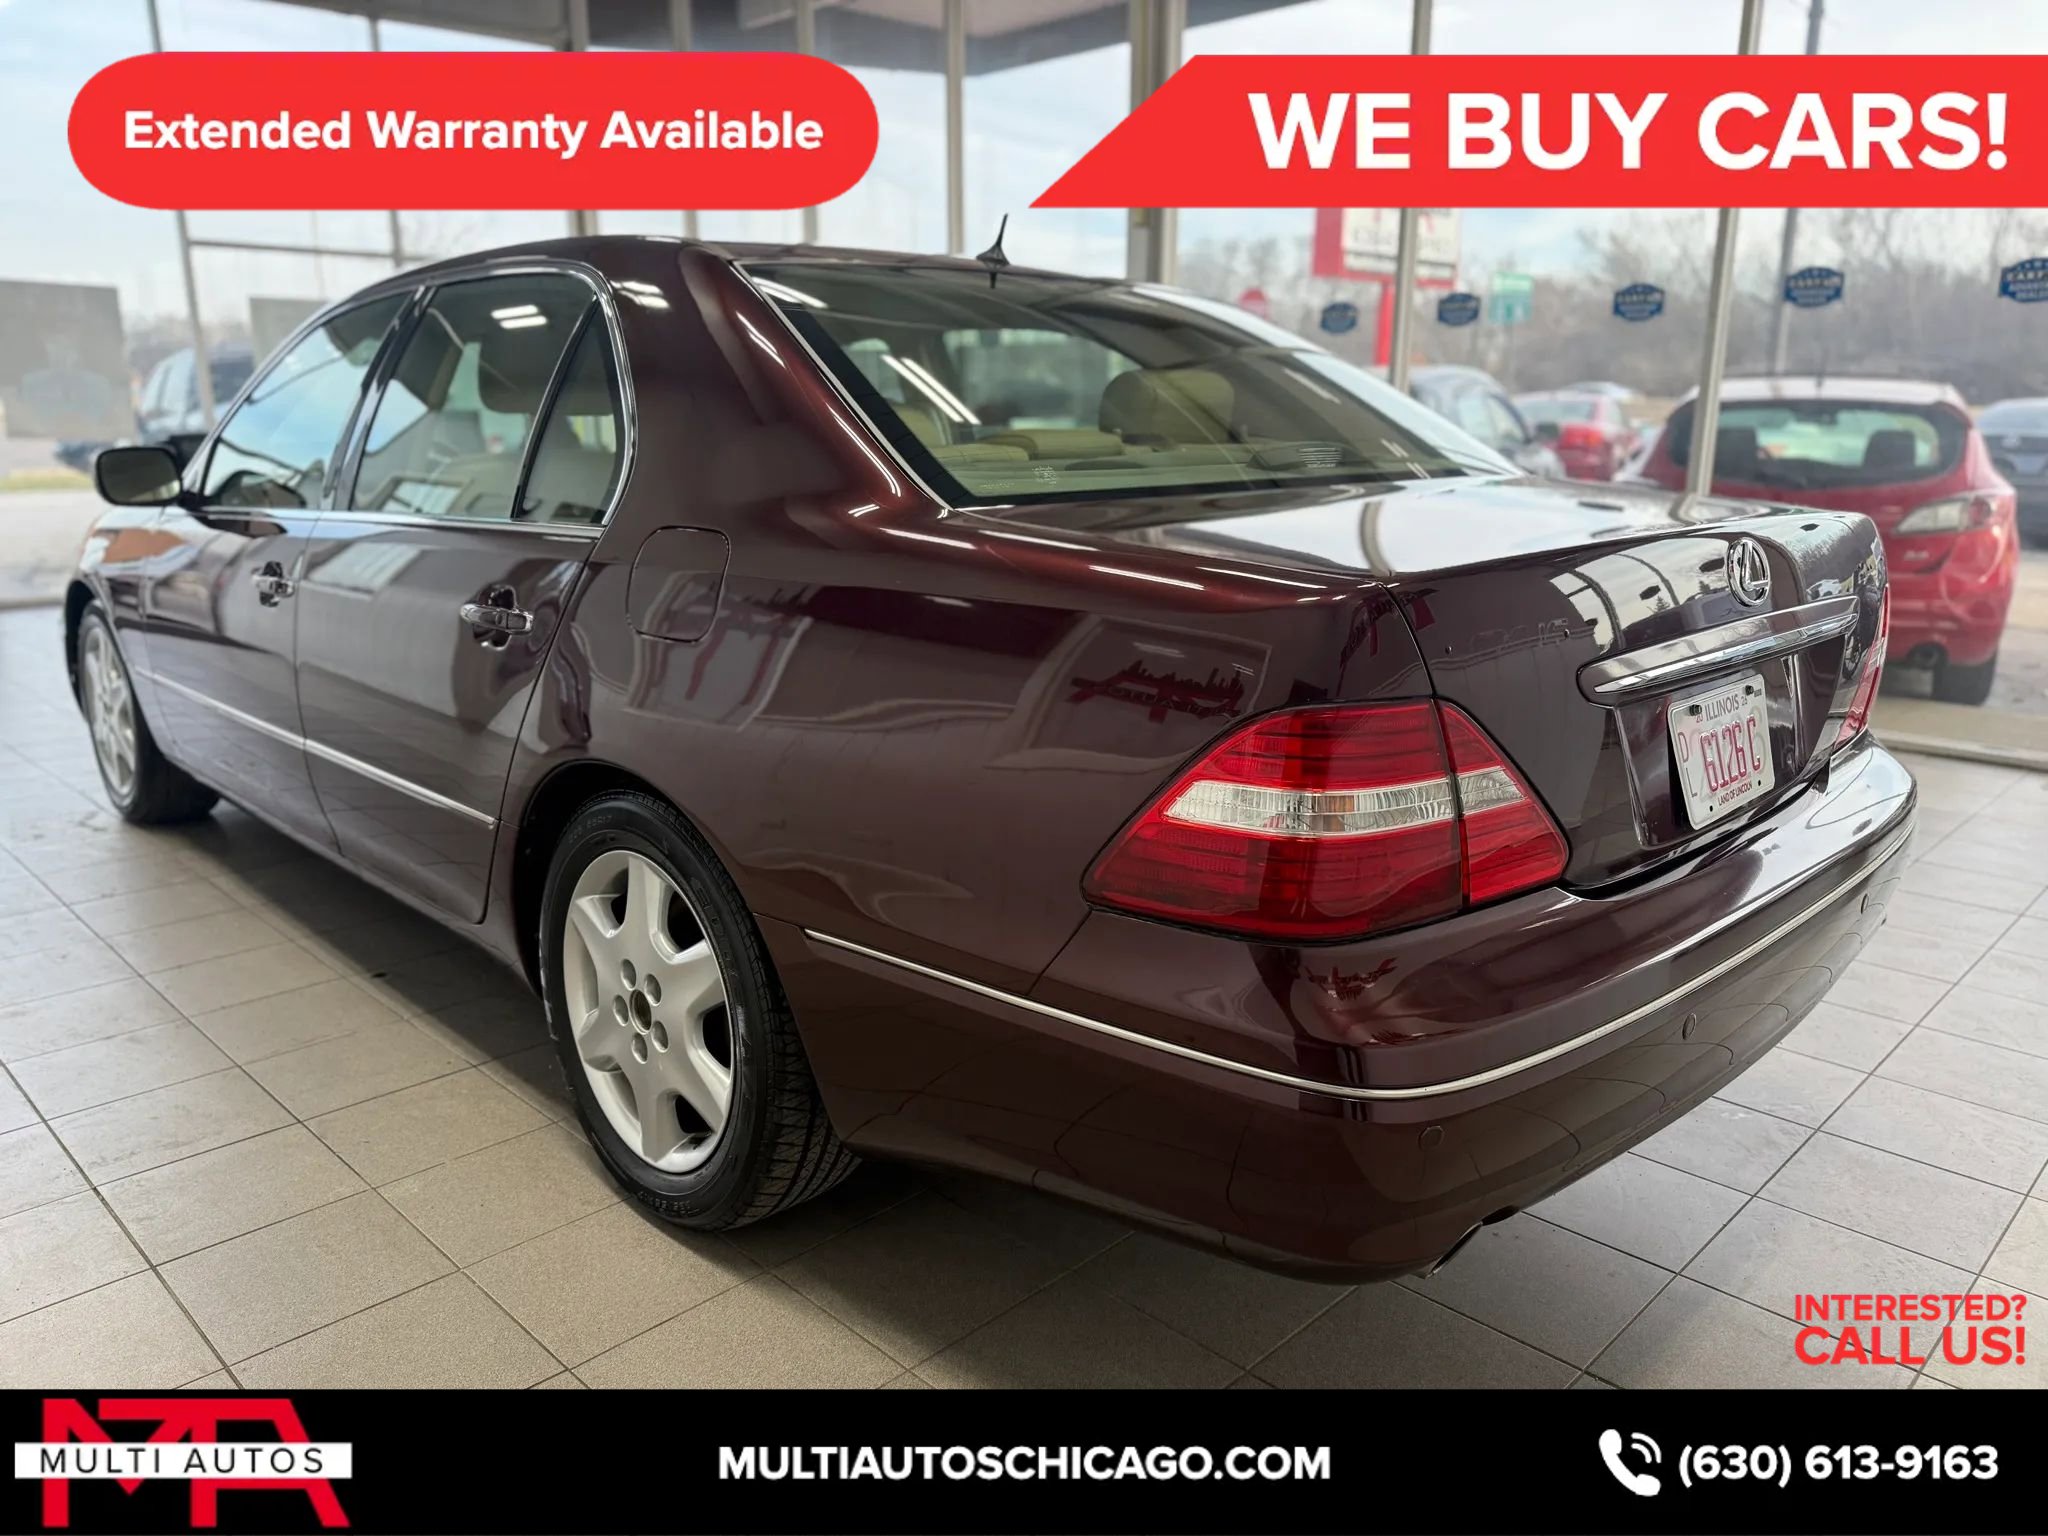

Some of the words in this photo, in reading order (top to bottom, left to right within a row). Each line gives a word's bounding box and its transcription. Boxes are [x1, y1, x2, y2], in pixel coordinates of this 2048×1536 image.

[1704, 693, 1740, 722] ILLINOIS
[1699, 719, 1748, 793] 6126
[1746, 714, 1761, 772] C
[1717, 791, 1730, 806] LAND
[1735, 780, 1753, 797] LINCOLN
